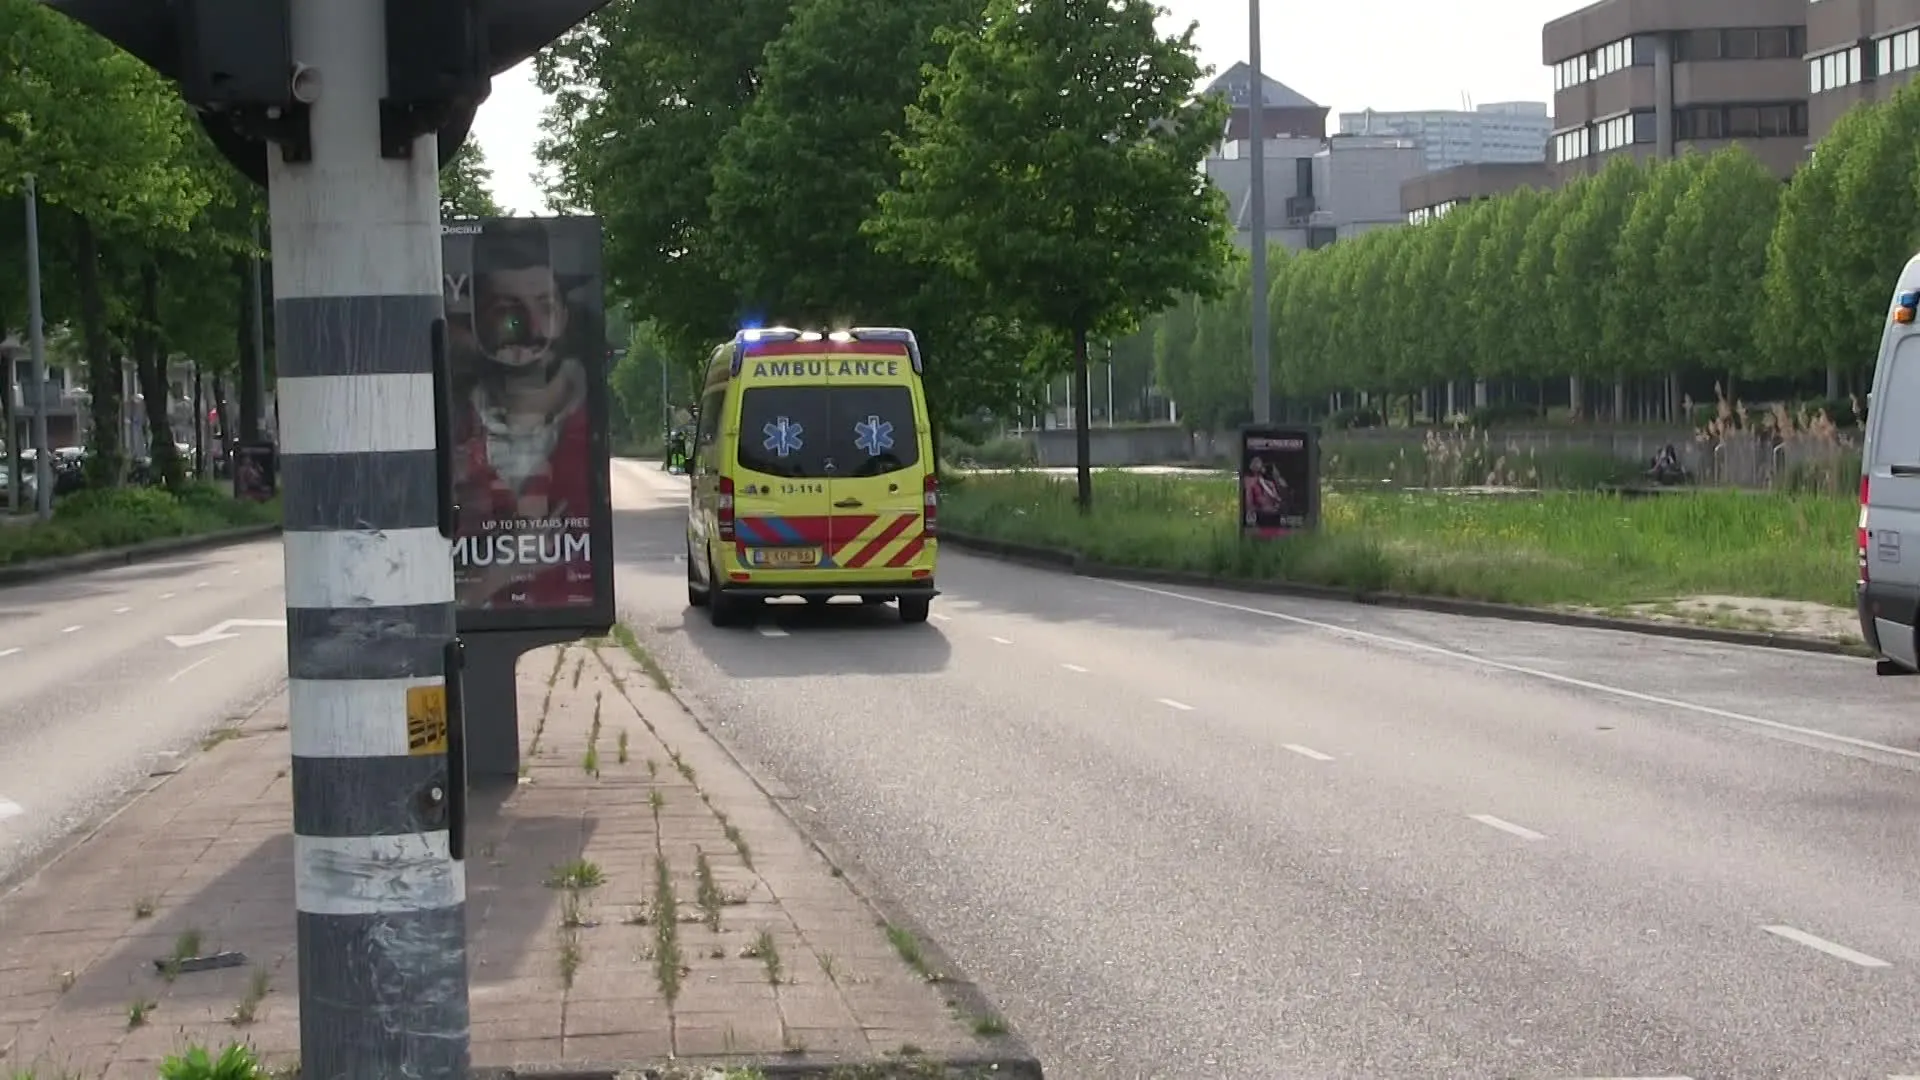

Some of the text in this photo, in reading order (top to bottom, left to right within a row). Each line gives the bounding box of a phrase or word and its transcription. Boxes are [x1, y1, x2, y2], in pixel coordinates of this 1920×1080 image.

[753, 360, 899, 377] AMBULANCE
[780, 483, 823, 495] 13-114
[482, 517, 590, 530] UP TO 19 YEARS FREE
[451, 533, 591, 567] MUSEUM
